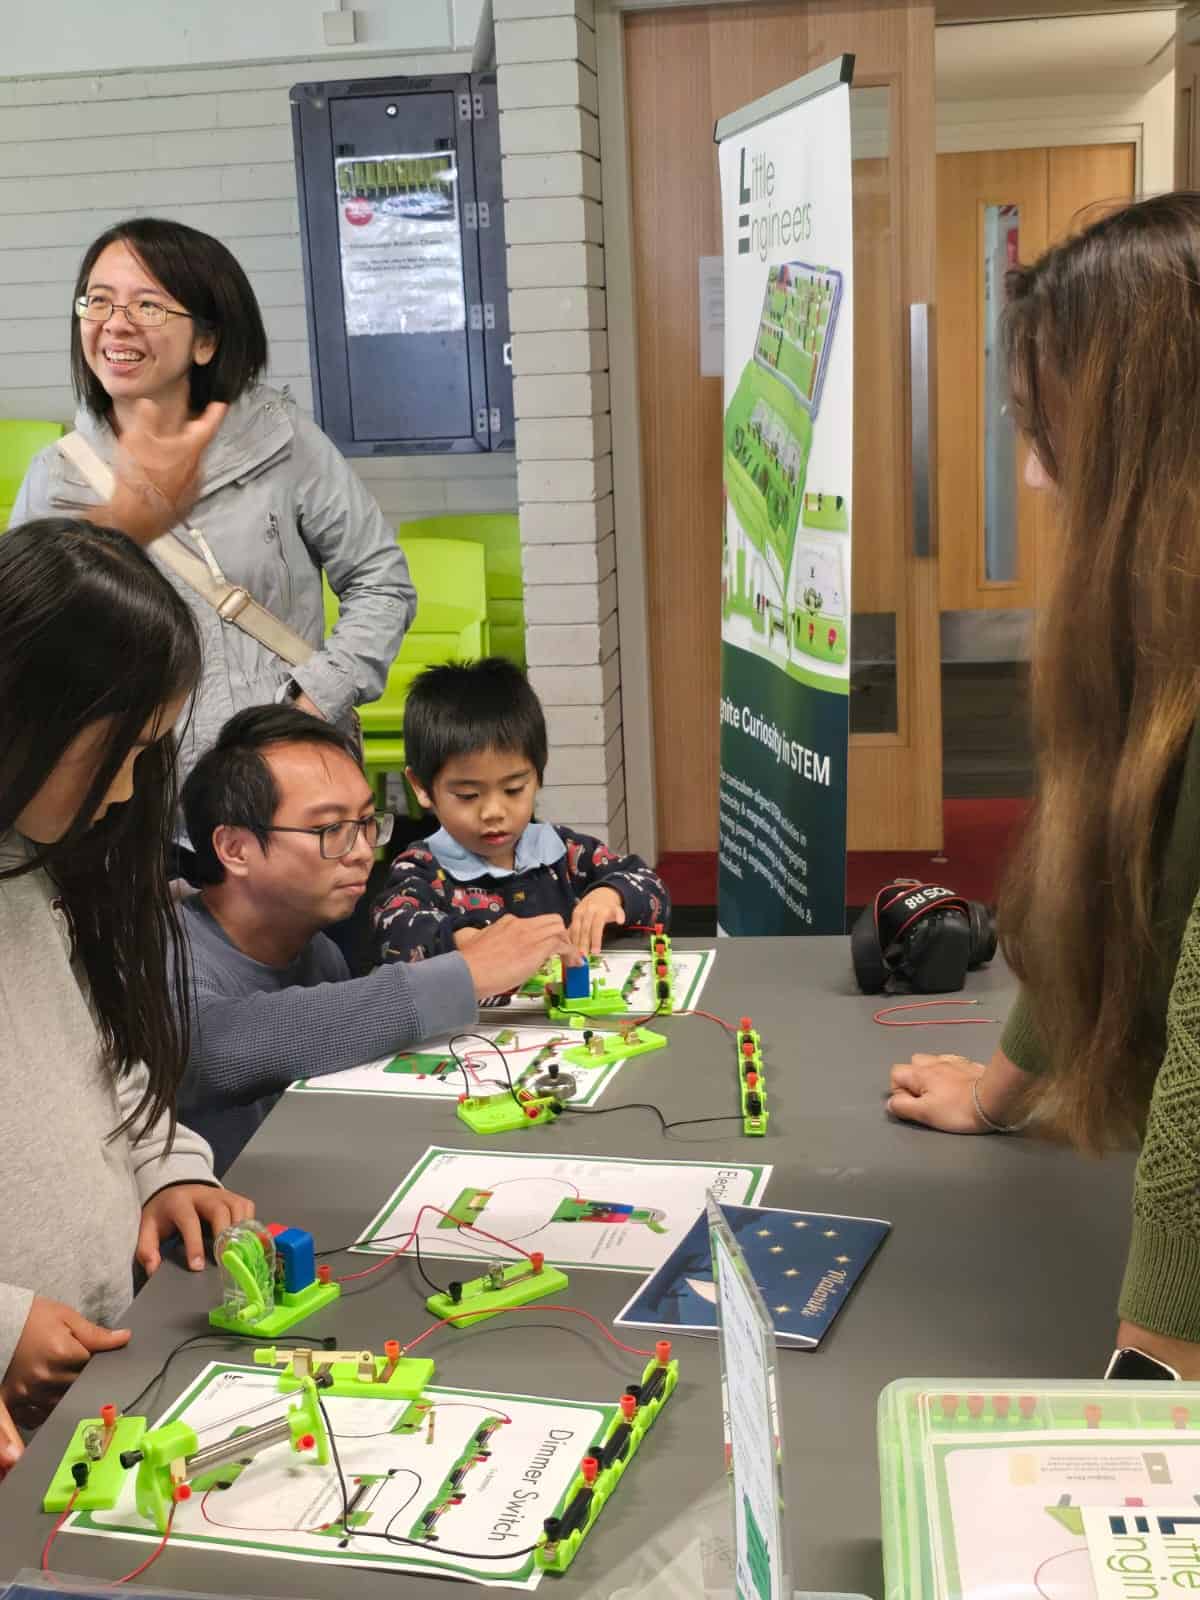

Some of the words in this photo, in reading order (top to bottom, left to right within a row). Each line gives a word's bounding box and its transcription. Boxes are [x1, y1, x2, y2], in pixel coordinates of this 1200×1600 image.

[739, 146, 776, 205] Little
[738, 200, 812, 263] Engineers
[719, 695, 740, 729] gnite
[742, 705, 781, 764] Curiosity
[791, 743, 831, 788] STEM
[904, 892, 926, 910] R8
[521, 1429, 575, 1485] Dimmer
[487, 1489, 539, 1542] Switch
[1106, 1515, 1167, 1600] Engin
